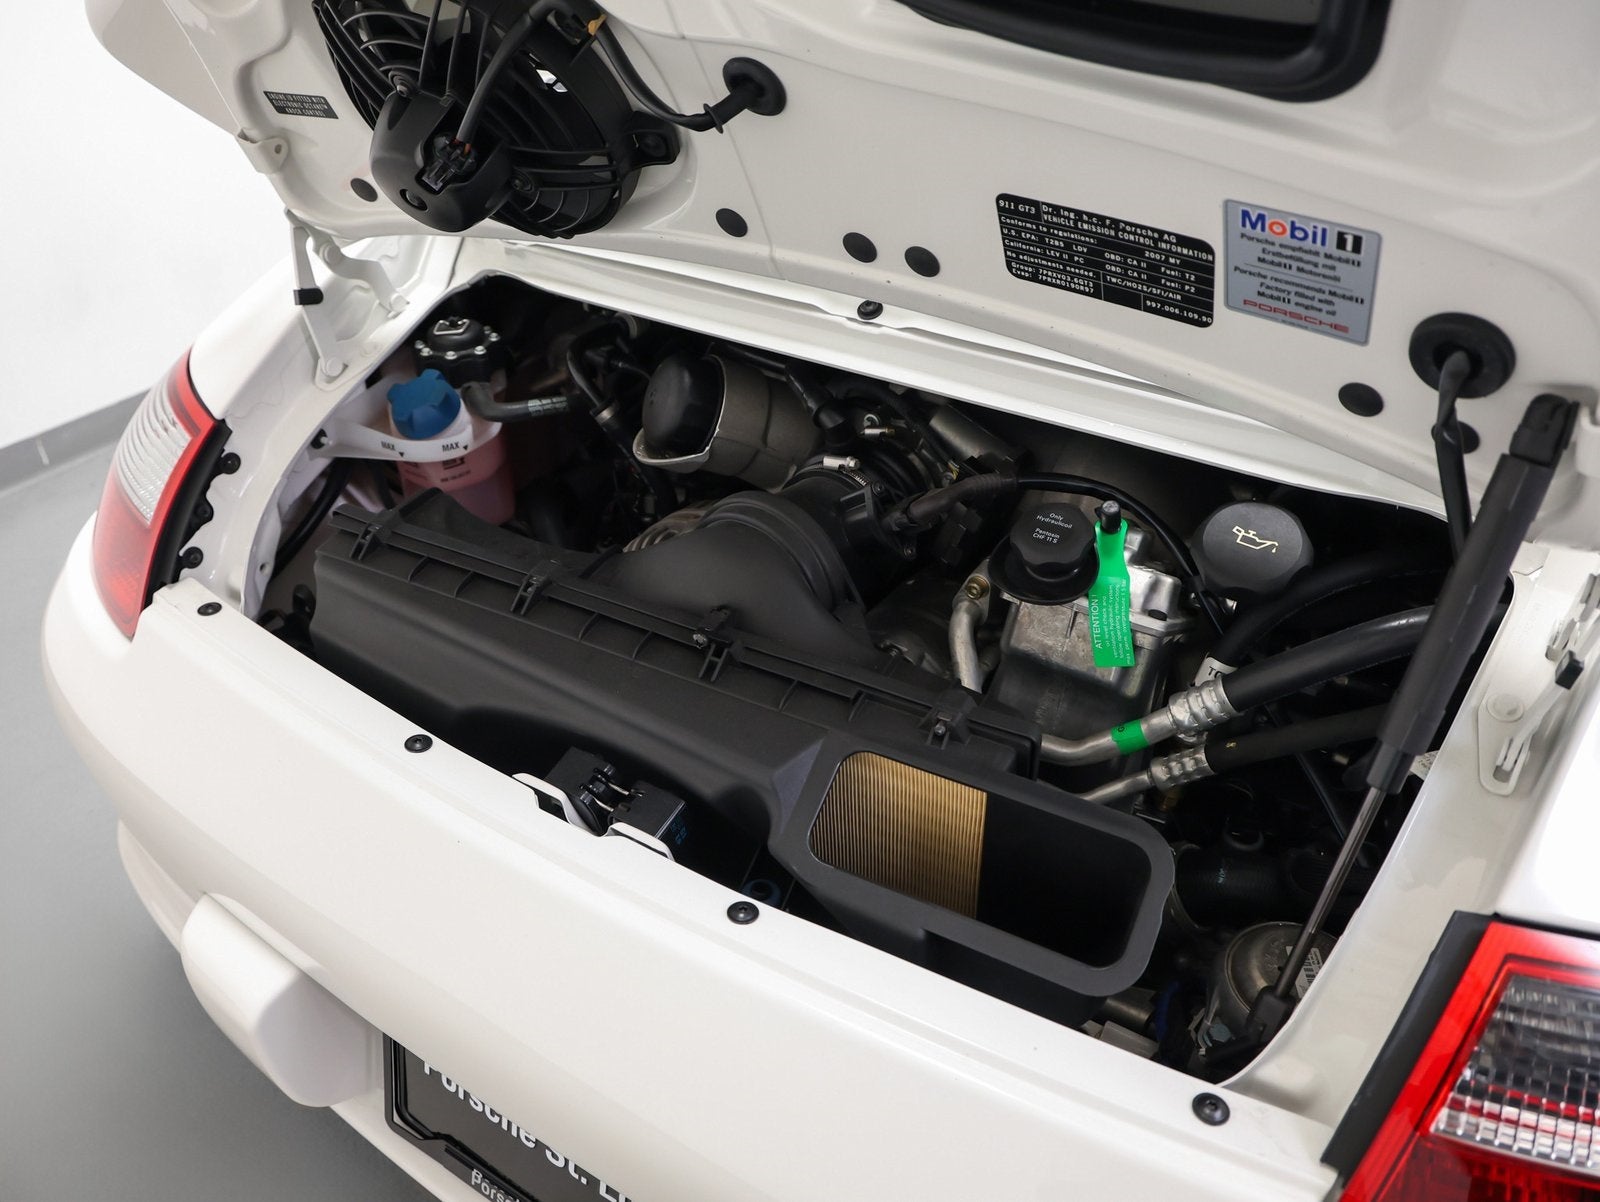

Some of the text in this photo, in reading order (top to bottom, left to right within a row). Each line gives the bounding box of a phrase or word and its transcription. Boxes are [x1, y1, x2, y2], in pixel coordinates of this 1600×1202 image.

[999, 200, 1035, 214] 911 GT3
[1001, 216, 1036, 229] Conforms
[1050, 227, 1098, 245] regulations:
[1042, 204, 1176, 242] Dr. Ing. h.c. F. Porsche AG
[1242, 209, 1328, 248] Mobil
[1003, 227, 1018, 236] U.S.
[1022, 232, 1038, 241] EPA:
[1044, 214, 1212, 261] VEHICLE EMISSION CONTROL INFORMATION
[1241, 233, 1275, 247] Porsche
[1005, 239, 1043, 254] California:
[1047, 249, 1060, 257] LEV
[1074, 256, 1084, 264] PC
[1105, 252, 1124, 262] OBD:
[1128, 258, 1138, 266] CA
[1145, 251, 1180, 265] 2007 MY
[1011, 262, 1035, 272] Group:
[1012, 268, 1032, 278] Evap:
[1019, 253, 1063, 270] adjustments
[1066, 266, 1096, 278] needed.
[1106, 264, 1124, 274] OBD:
[1322, 263, 1336, 272] mit
[1161, 266, 1195, 281] Fuel: T2
[1234, 266, 1267, 280] Porsche
[1271, 276, 1325, 295] recommends
[1162, 278, 1195, 293] Fuel: P2
[1260, 282, 1292, 296] Factory
[1318, 297, 1335, 307] with
[1146, 300, 1212, 323] 997.006.109.90
[1244, 299, 1349, 333] PORSCHE
[1295, 301, 1322, 314] engine
[1326, 309, 1336, 317] oil
[442, 442, 459, 452] MAX
[1091, 598, 1102, 649] ATTENTION
